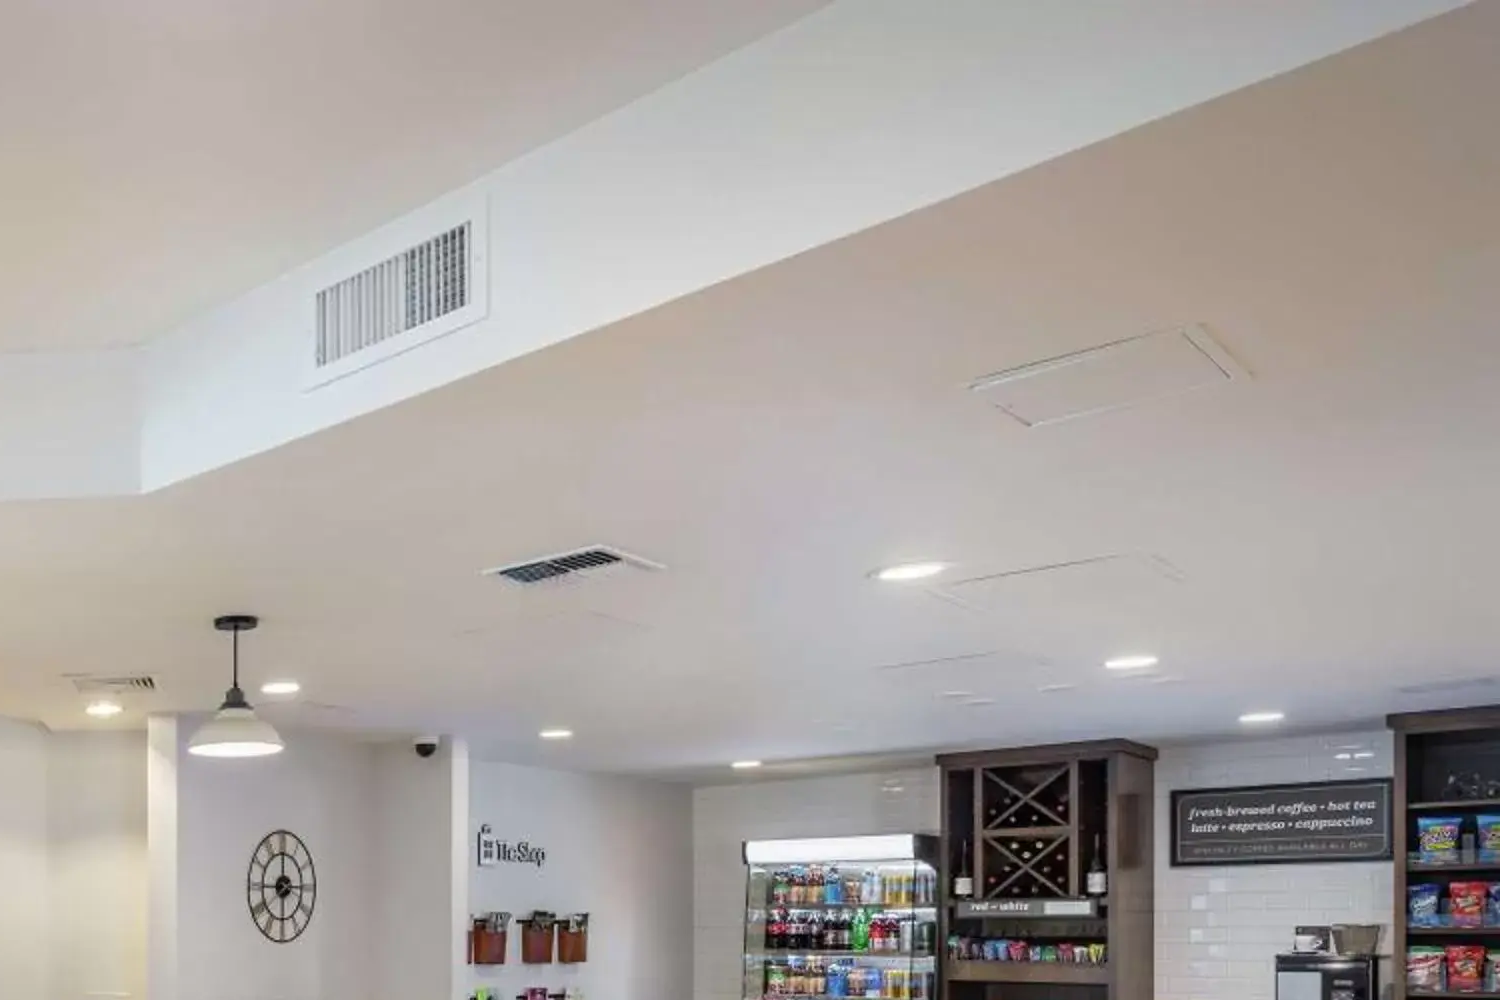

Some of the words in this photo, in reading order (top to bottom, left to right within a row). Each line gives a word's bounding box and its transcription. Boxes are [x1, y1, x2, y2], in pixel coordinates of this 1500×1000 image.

[1277, 801, 1317, 816] coffee
[1327, 801, 1352, 811] hot
[1353, 800, 1377, 811] tea
[1191, 822, 1219, 833] latte
[1228, 820, 1286, 833] espresso
[1295, 815, 1374, 831] cappuccino
